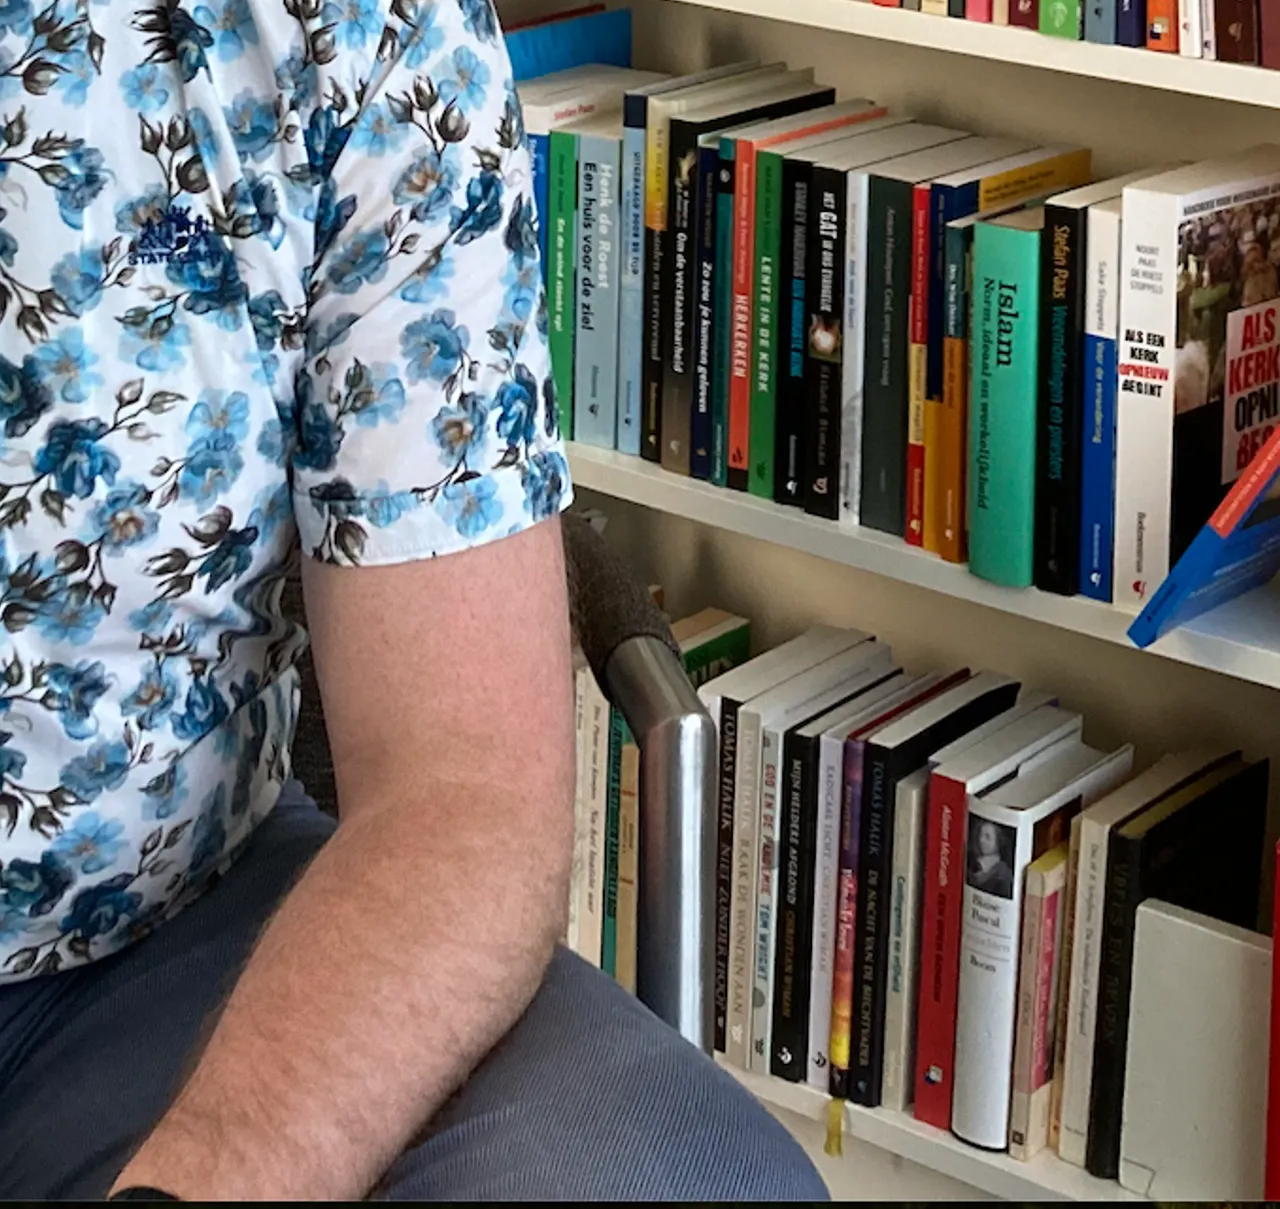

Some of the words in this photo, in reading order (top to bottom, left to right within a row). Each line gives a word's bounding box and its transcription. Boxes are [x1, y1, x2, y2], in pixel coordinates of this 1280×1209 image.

[582, 162, 596, 192] Een
[581, 197, 596, 229] huis
[819, 212, 838, 238] GAT
[581, 234, 593, 272] voor
[1052, 225, 1070, 265] Stefan
[580, 277, 595, 298] de
[1051, 269, 1069, 298] Paas
[580, 303, 596, 331] ziel
[995, 281, 1019, 367] Islam
[1241, 307, 1276, 351] ALS
[733, 295, 749, 378] HERKERKEN
[1125, 329, 1143, 344] ALS
[1146, 332, 1165, 348] EEN
[1130, 347, 1159, 364] KERK
[1228, 344, 1280, 395] KERK
[1118, 363, 1169, 381] OPNIEUW
[1121, 380, 1163, 398] BEGINT
